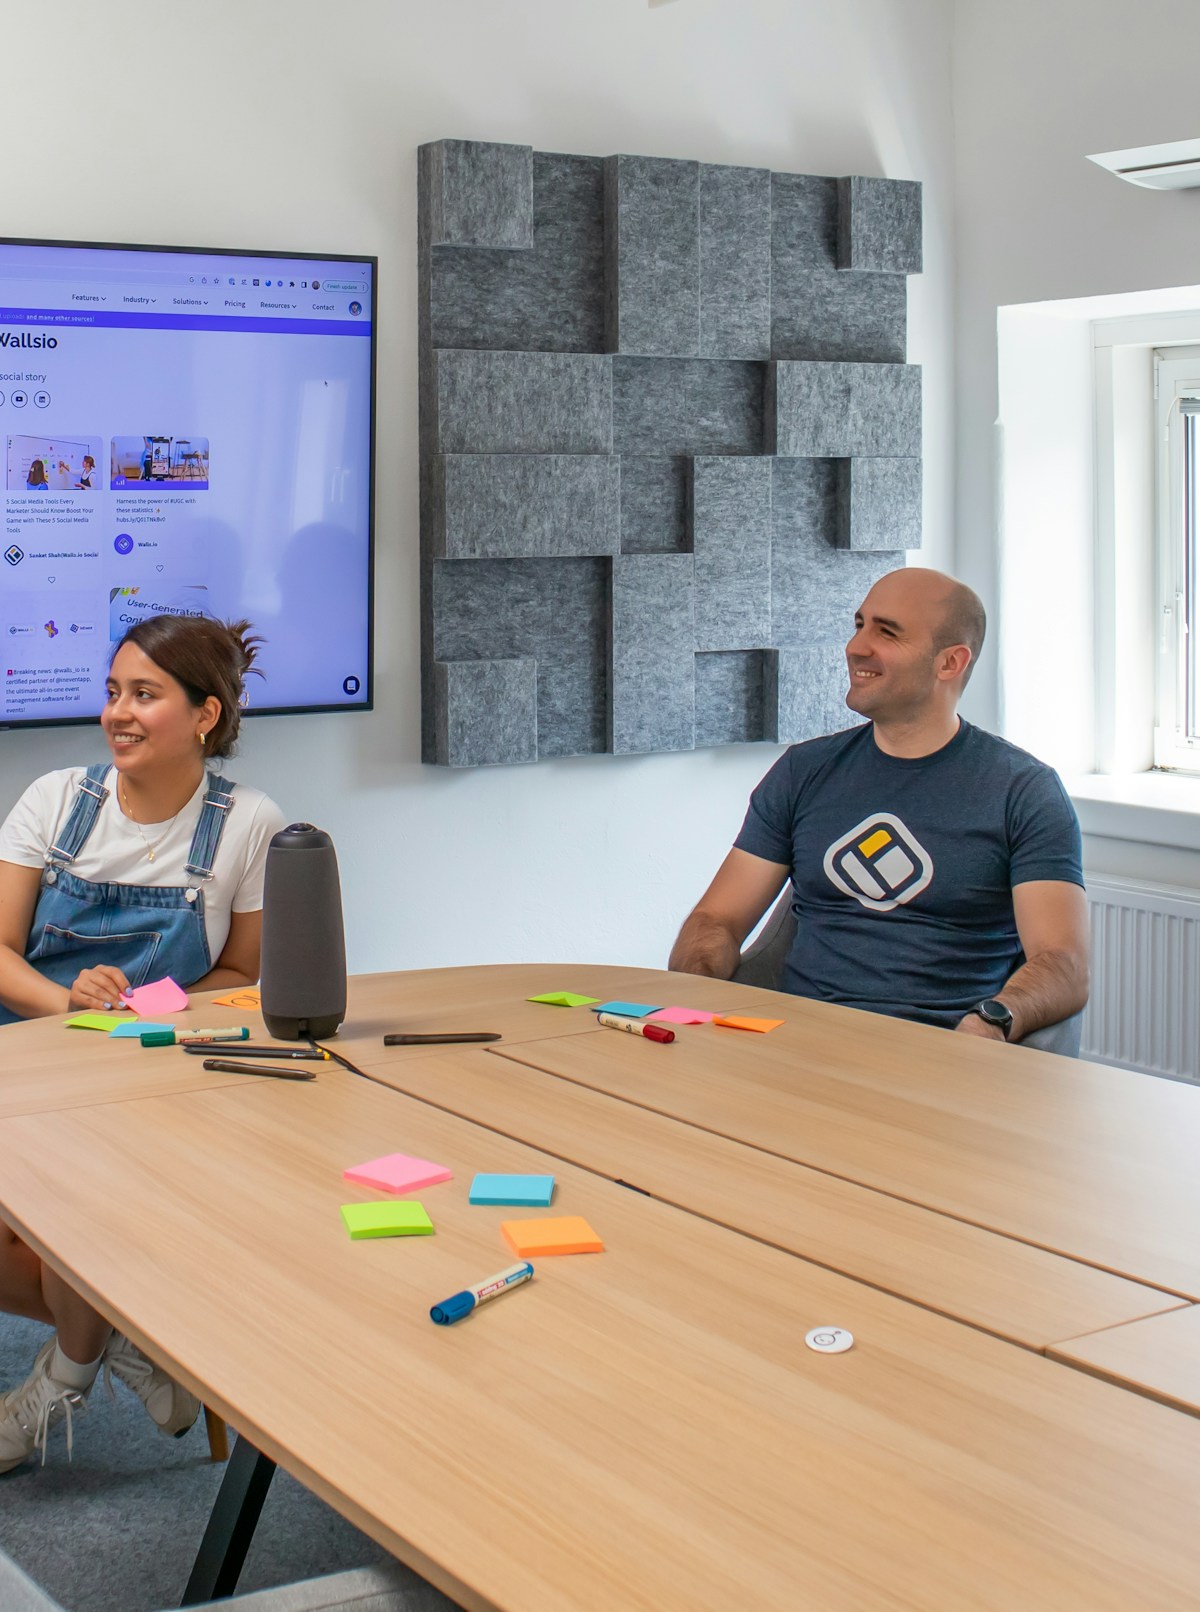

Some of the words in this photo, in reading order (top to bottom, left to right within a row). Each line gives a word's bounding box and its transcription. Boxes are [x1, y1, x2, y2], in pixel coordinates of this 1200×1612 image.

[72, 294, 100, 302] Features
[123, 296, 150, 305] Industry
[172, 298, 202, 306] Solutions
[224, 300, 246, 309] Pricing
[260, 302, 290, 310] Resources
[0, 372, 24, 382] social
[25, 373, 48, 384] story
[126, 598, 204, 618] User-Generated
[119, 613, 142, 626] Cont
